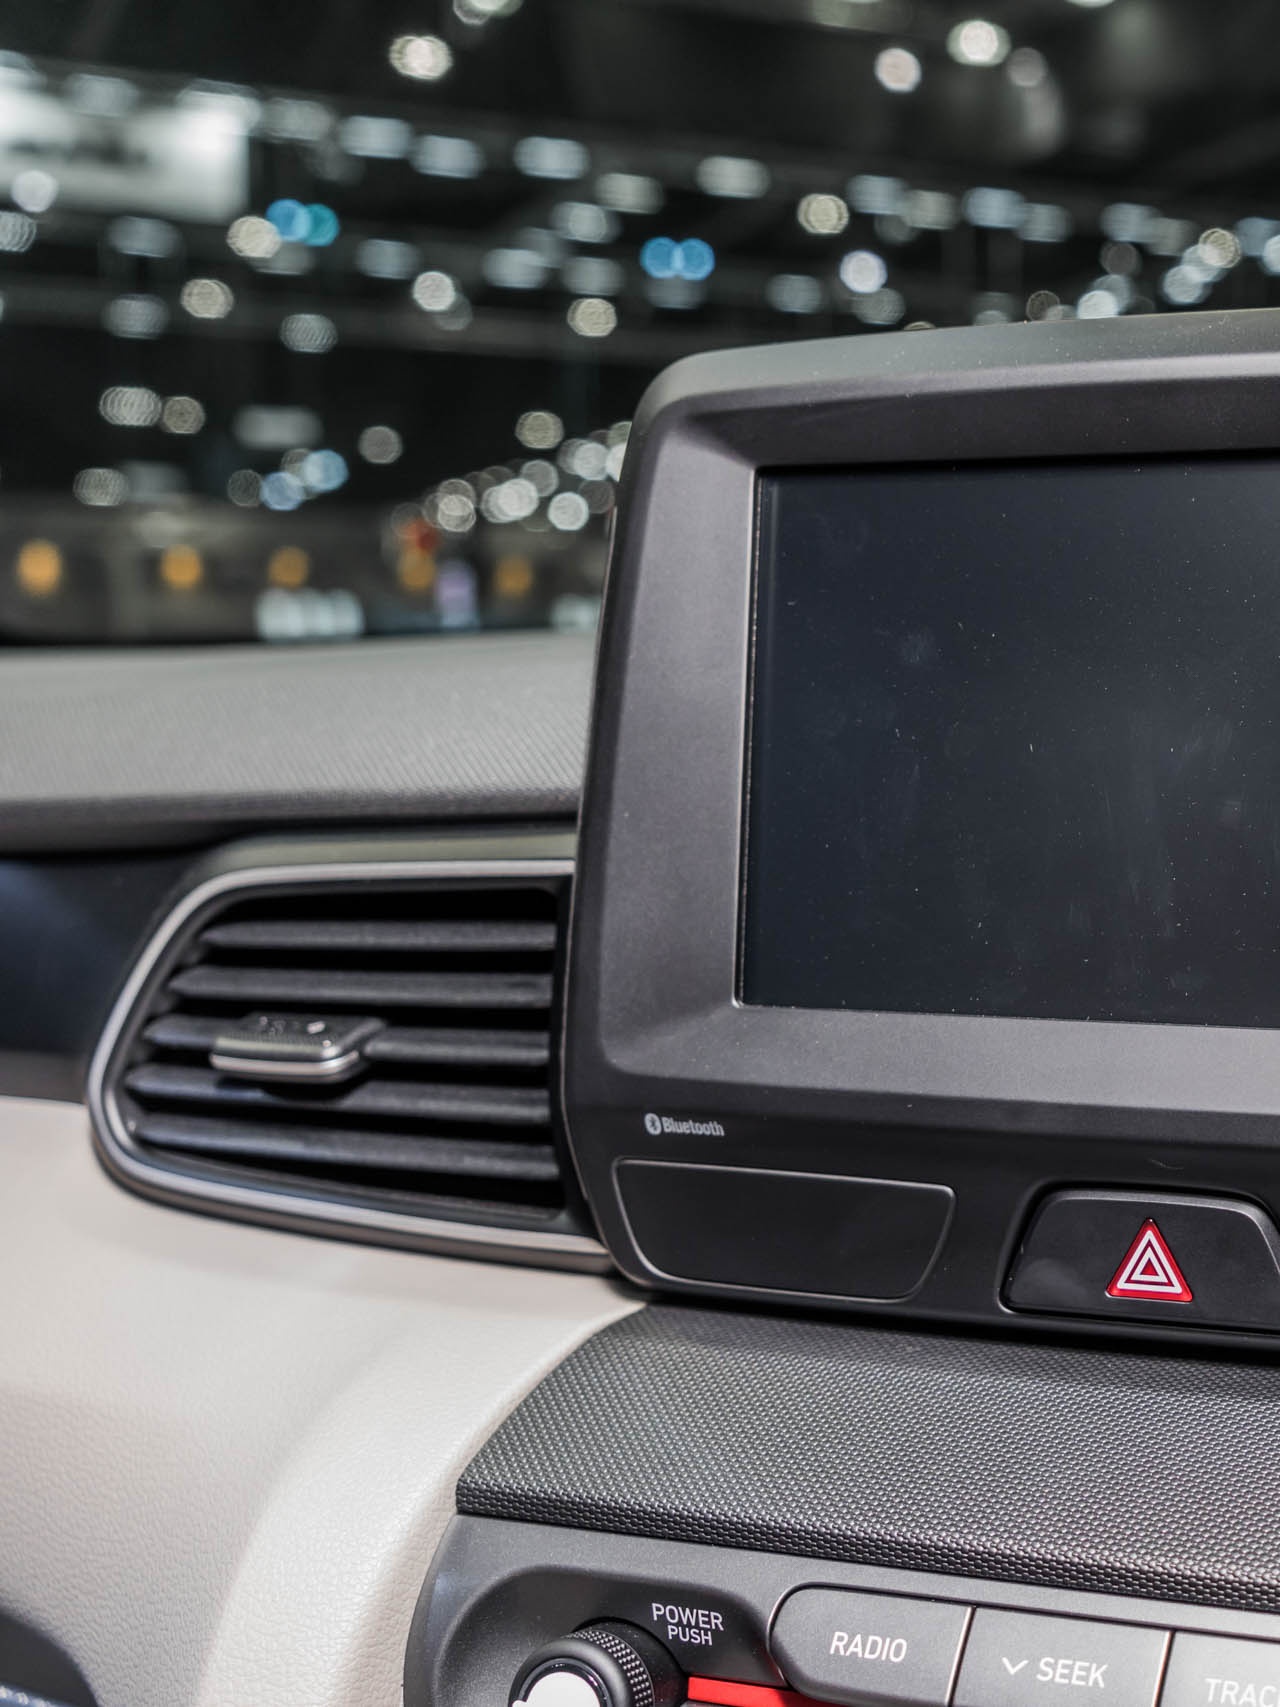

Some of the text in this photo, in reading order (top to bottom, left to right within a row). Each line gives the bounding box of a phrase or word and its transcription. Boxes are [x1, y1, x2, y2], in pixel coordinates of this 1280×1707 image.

[661, 1117, 725, 1137] Bluetooth
[652, 1603, 724, 1631] POWER
[667, 1624, 713, 1646] PUSH
[829, 1631, 908, 1662] RADIO
[1036, 1656, 1108, 1688] SEEK
